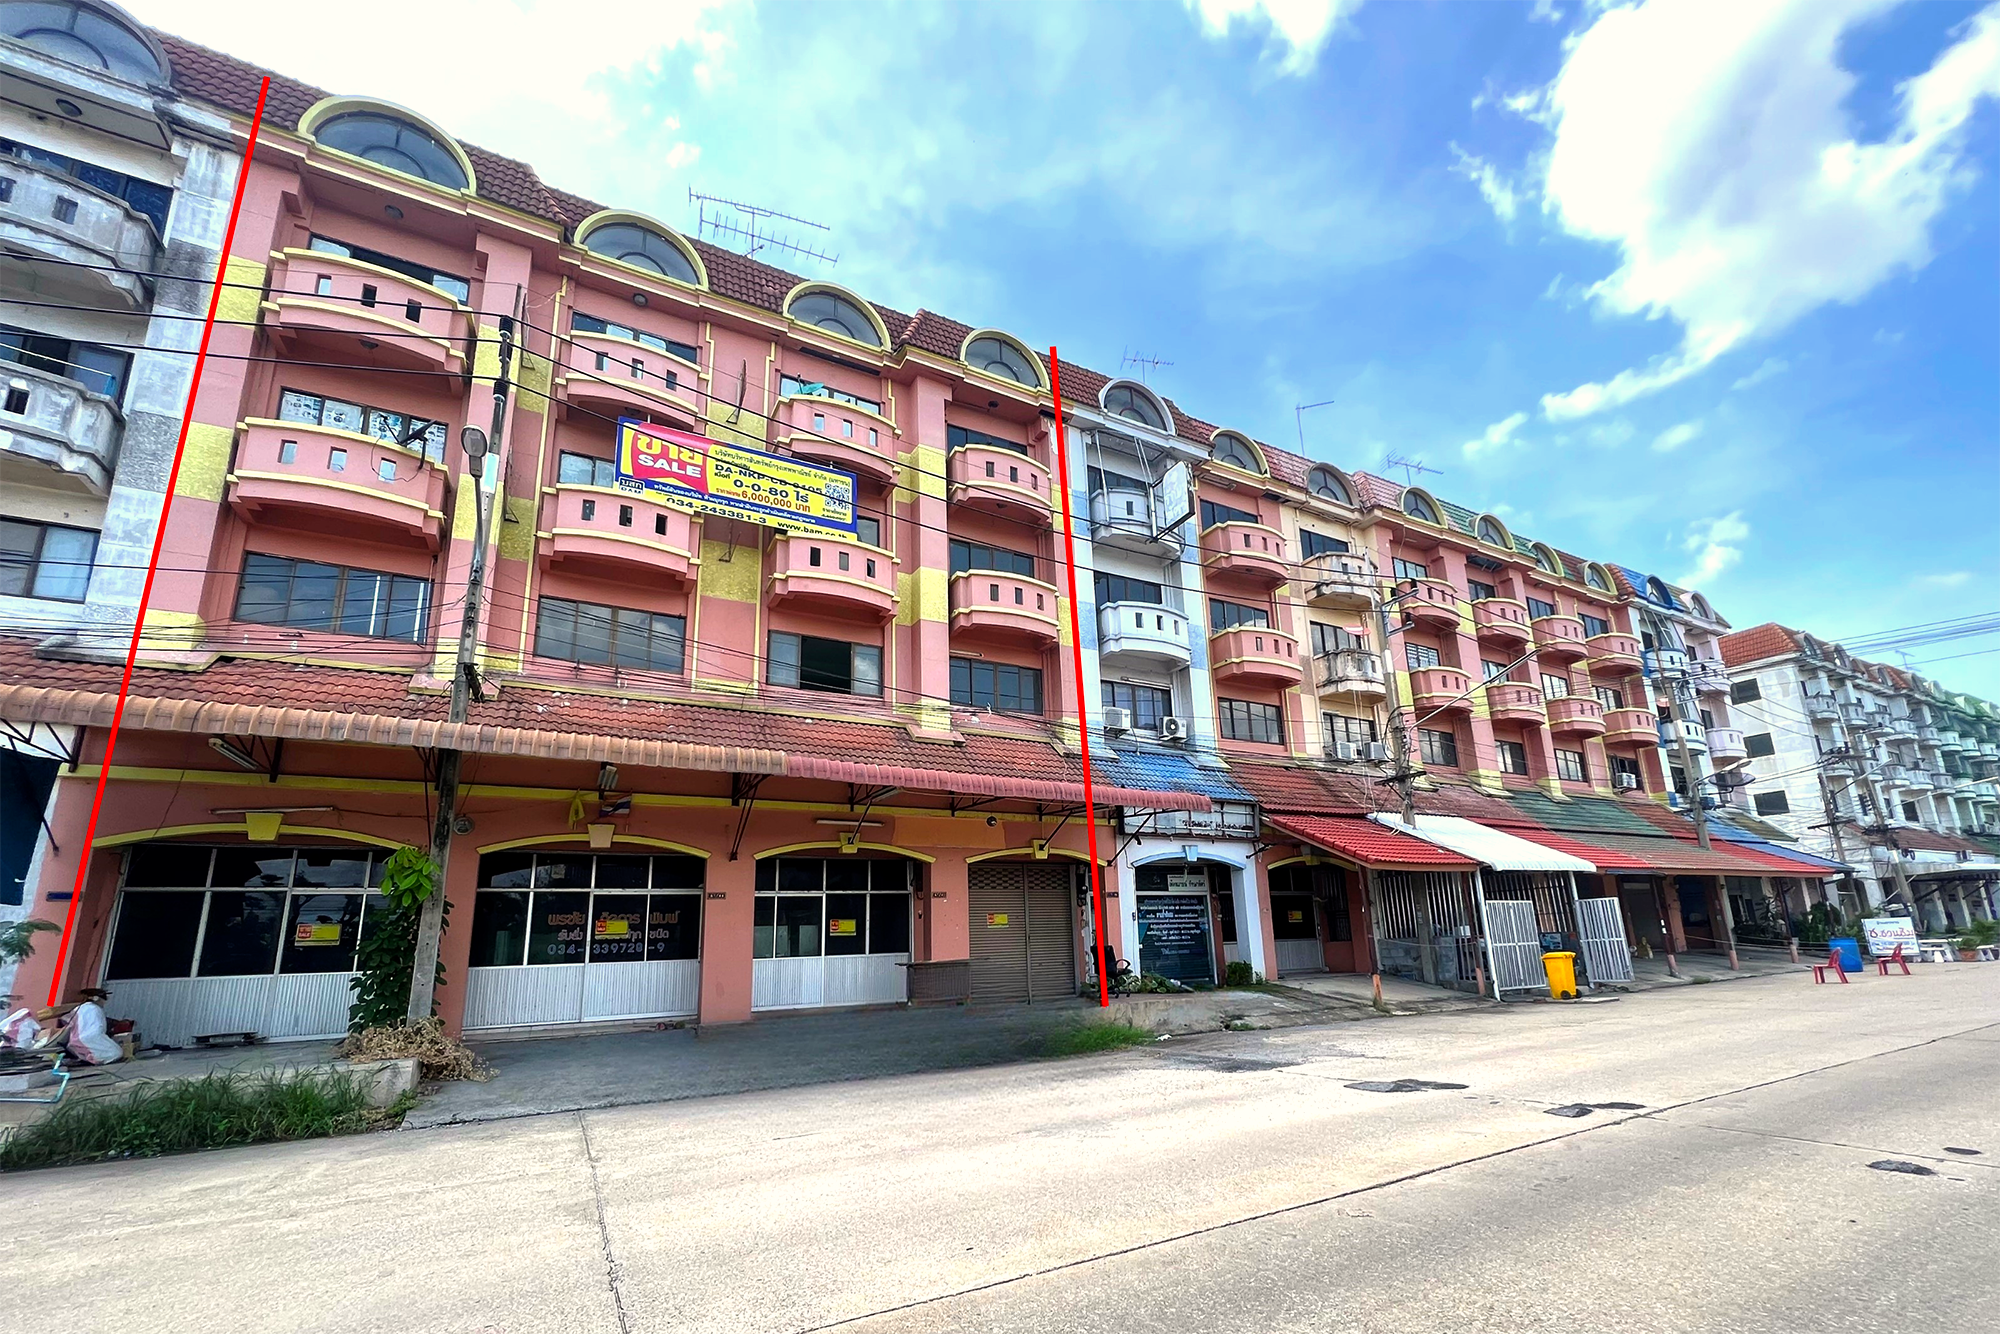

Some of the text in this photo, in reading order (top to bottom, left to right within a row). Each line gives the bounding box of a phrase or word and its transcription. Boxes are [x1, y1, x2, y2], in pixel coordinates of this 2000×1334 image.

[636, 434, 704, 466] ขาย
[637, 454, 702, 478] SALE
[620, 479, 643, 490] บสก
[733, 479, 789, 499] 0-0-80
[666, 496, 767, 525] 034-243381-3
[740, 490, 792, 509] 6,000,000
[795, 502, 811, 513] บาท
